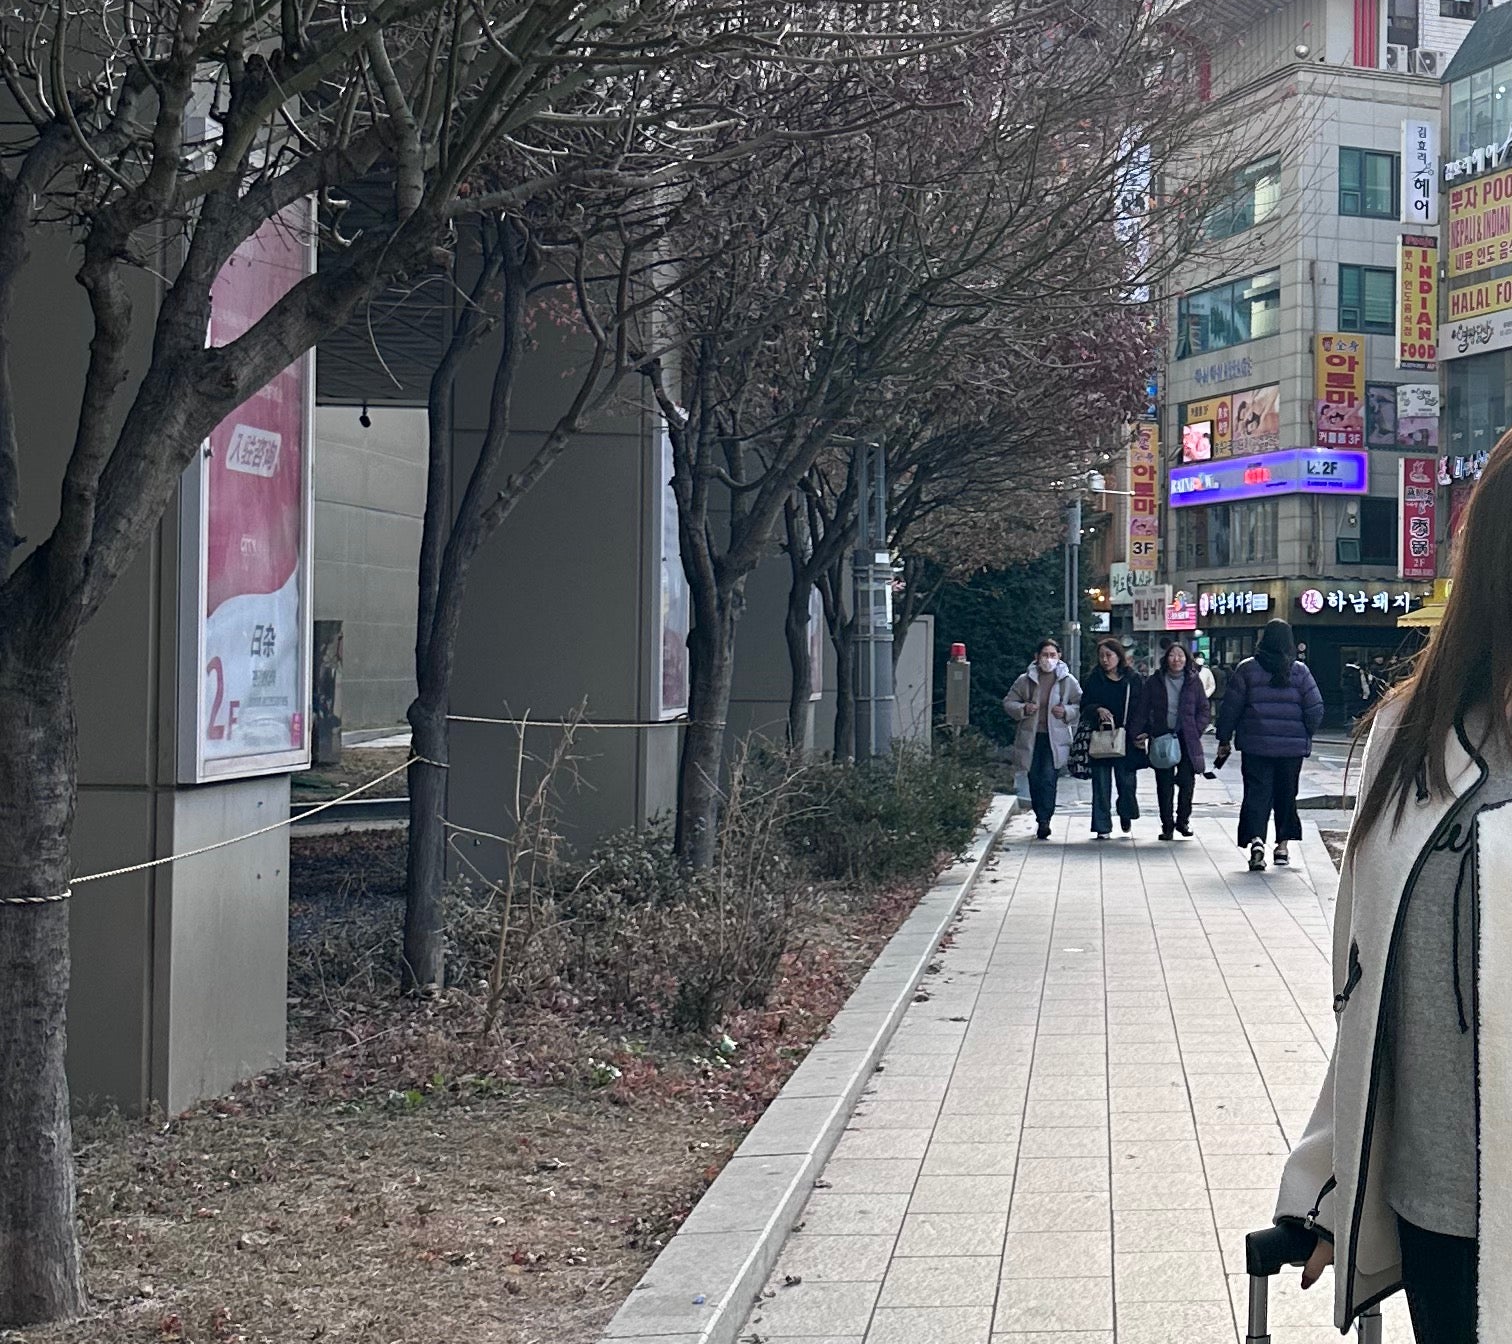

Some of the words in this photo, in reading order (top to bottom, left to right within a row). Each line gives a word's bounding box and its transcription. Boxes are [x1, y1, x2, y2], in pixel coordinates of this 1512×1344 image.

[1414, 178, 1429, 219] 헤어
[1451, 215, 1475, 250] NEPALI
[1476, 215, 1482, 242] &
[1483, 204, 1510, 240] INDIAN
[1477, 245, 1495, 266] 인도
[1416, 250, 1433, 340] INDIAN
[1452, 286, 1491, 316] HALAL
[1400, 342, 1436, 359] FOOD
[1325, 354, 1359, 408] 아로마
[1348, 433, 1361, 444] 3F
[1322, 461, 1338, 475] 2F
[1133, 464, 1157, 515] 아로마
[1132, 541, 1154, 555] 3F
[251, 623, 276, 658] 日杂
